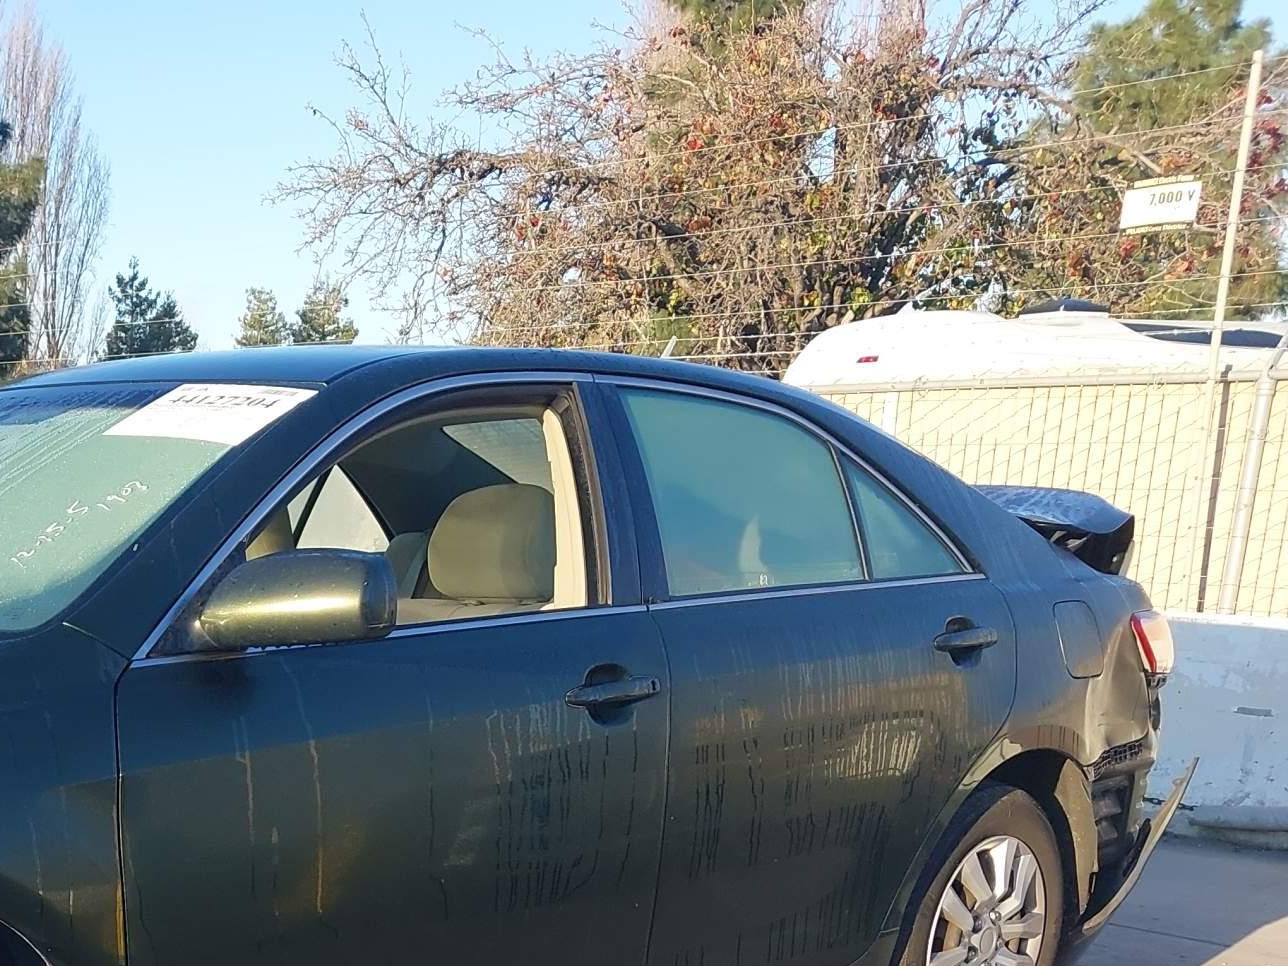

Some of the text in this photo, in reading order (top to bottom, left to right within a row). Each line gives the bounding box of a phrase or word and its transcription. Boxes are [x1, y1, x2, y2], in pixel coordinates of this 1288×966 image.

[1149, 189, 1196, 207] 7,000 V
[169, 394, 281, 408] 44127204
